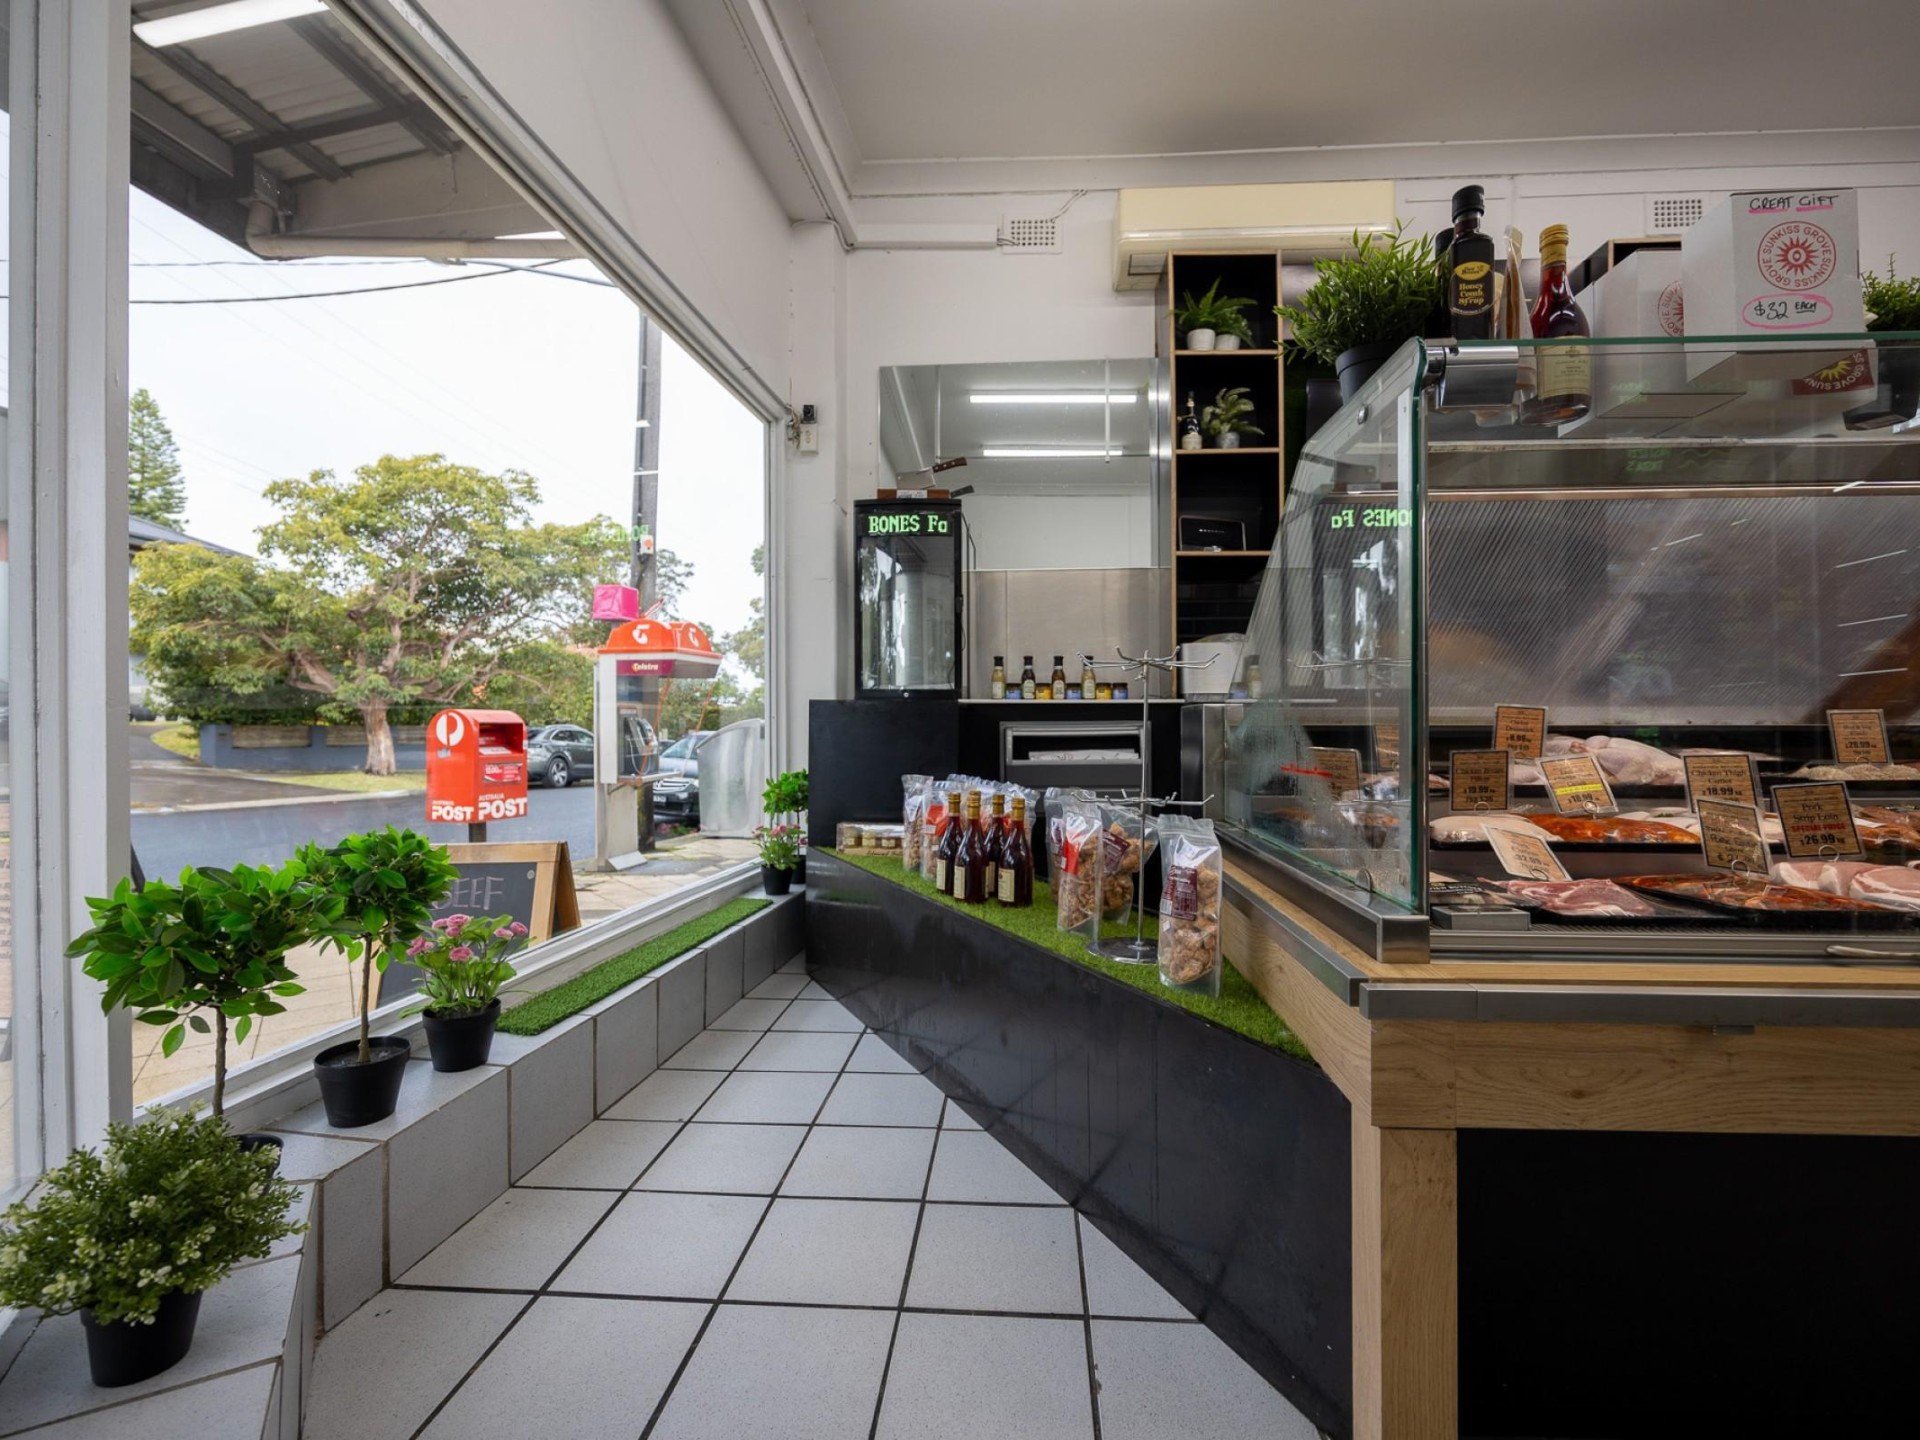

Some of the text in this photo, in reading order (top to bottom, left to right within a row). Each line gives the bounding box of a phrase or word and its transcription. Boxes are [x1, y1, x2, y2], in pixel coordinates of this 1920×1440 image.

[1750, 196, 1794, 210] GREAT
[1763, 225, 1832, 255] SUNKISS GROVE
[1763, 257, 1832, 287] SUNKISS GROVE
[1459, 283, 1484, 292] Honey
[1458, 297, 1484, 306] Syrup
[1754, 301, 1788, 320] $32
[868, 515, 920, 533] BONES
[632, 663, 658, 672] Telstra
[432, 805, 474, 821] POST
[479, 797, 528, 820] POST
[1802, 803, 1823, 811] Pork
